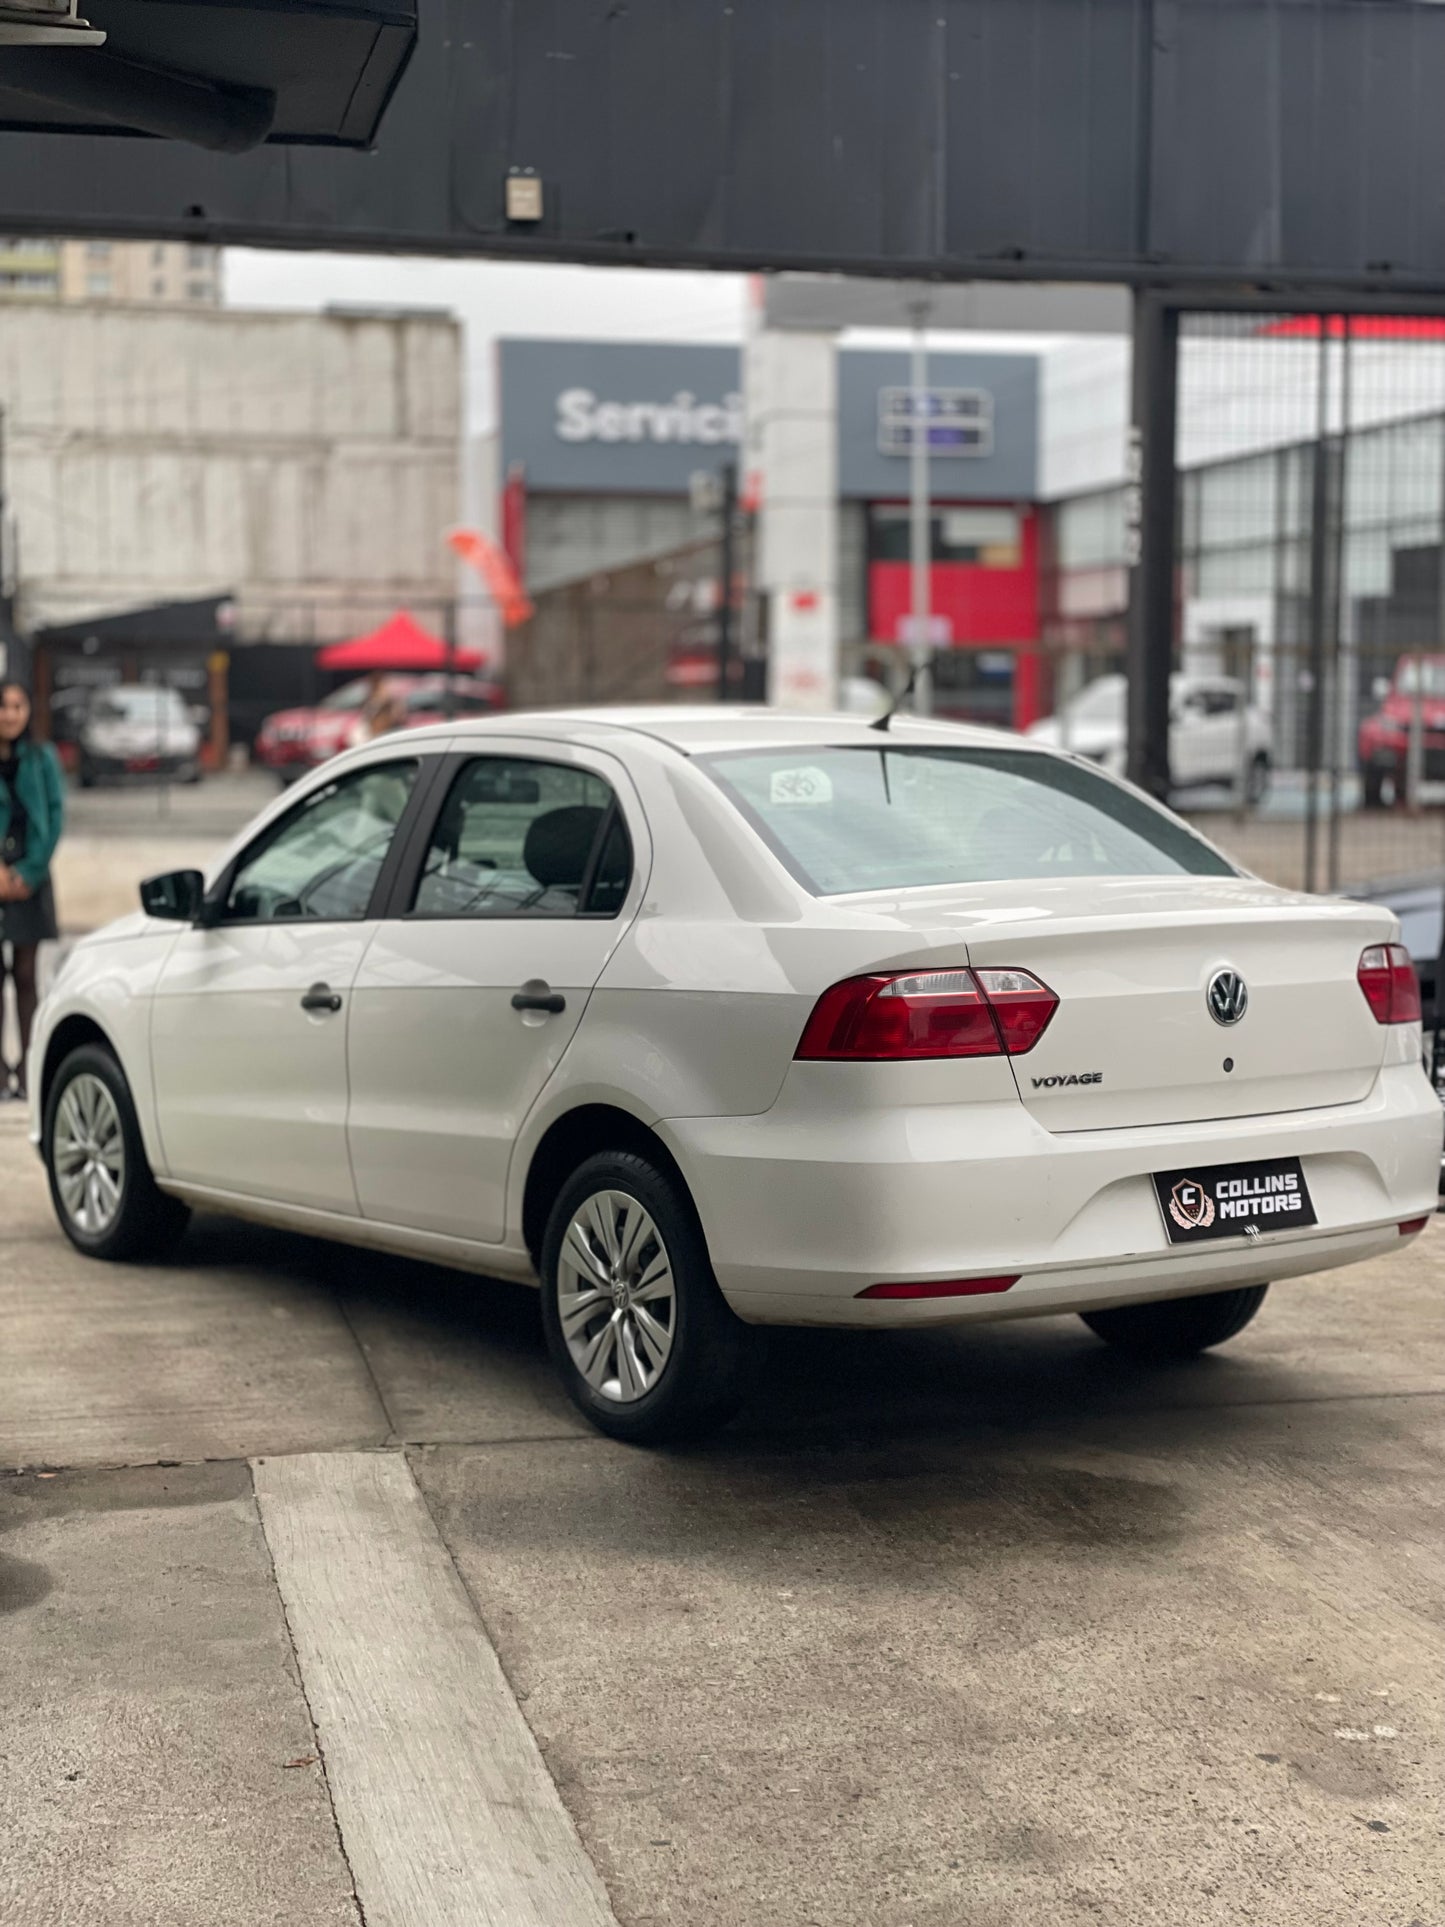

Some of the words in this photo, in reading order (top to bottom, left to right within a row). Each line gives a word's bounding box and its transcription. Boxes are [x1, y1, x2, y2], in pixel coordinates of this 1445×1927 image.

[1031, 1072, 1103, 1089] VOYAGE
[1182, 1188, 1196, 1205] C
[1216, 1173, 1298, 1199] COLLINS
[1220, 1193, 1302, 1219] MOTORS
